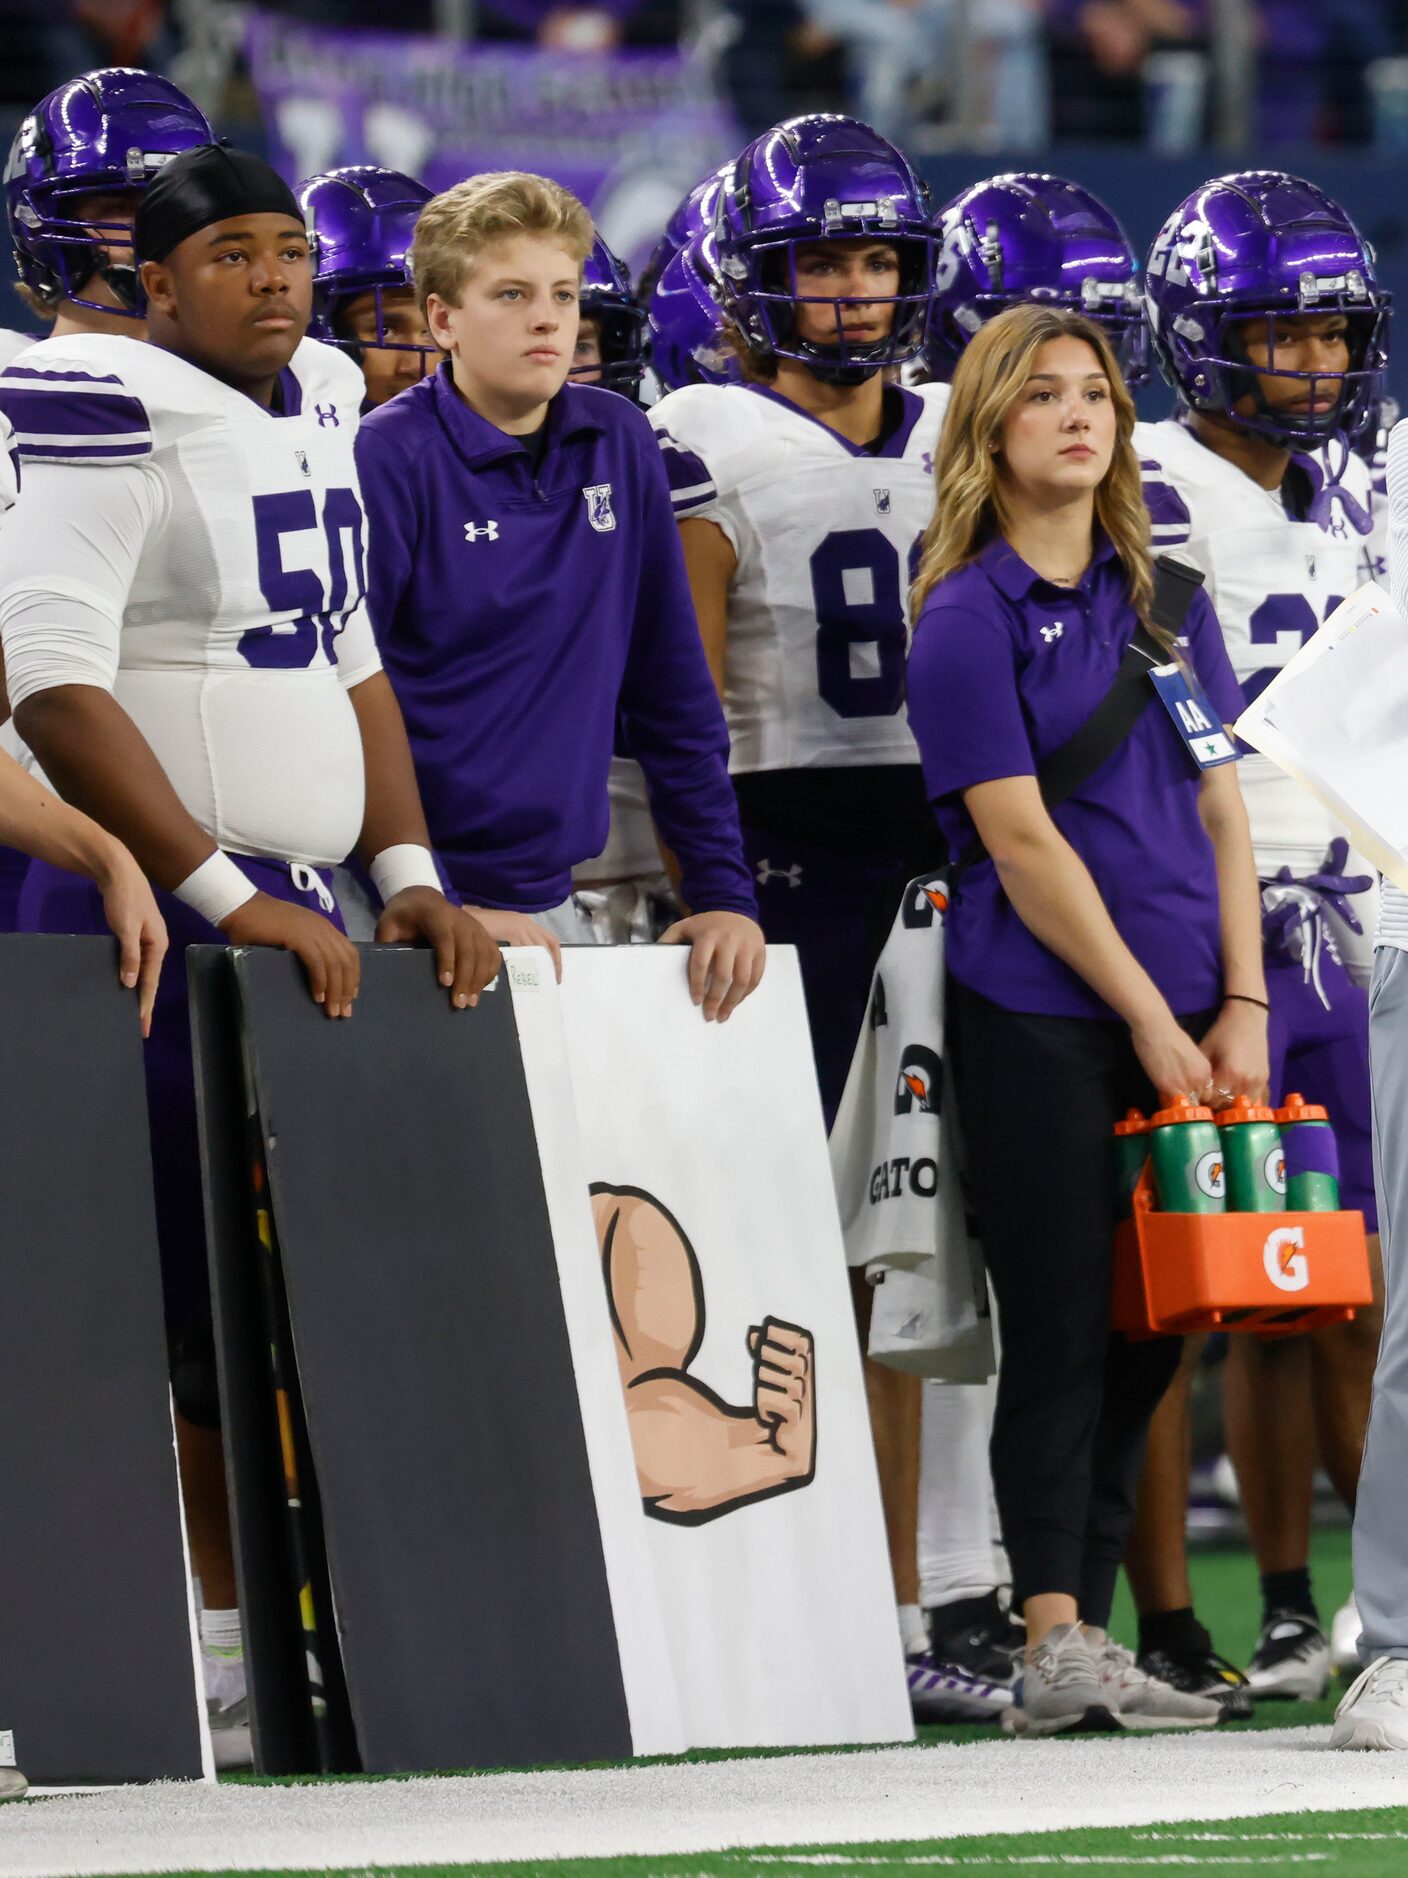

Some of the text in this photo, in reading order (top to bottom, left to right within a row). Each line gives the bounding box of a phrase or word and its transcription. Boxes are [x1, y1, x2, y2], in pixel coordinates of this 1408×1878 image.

[1146, 209, 1207, 288] 22
[237, 487, 366, 669] 50
[809, 527, 925, 719] 8
[1175, 699, 1213, 733] AA
[1263, 1226, 1311, 1292] G
